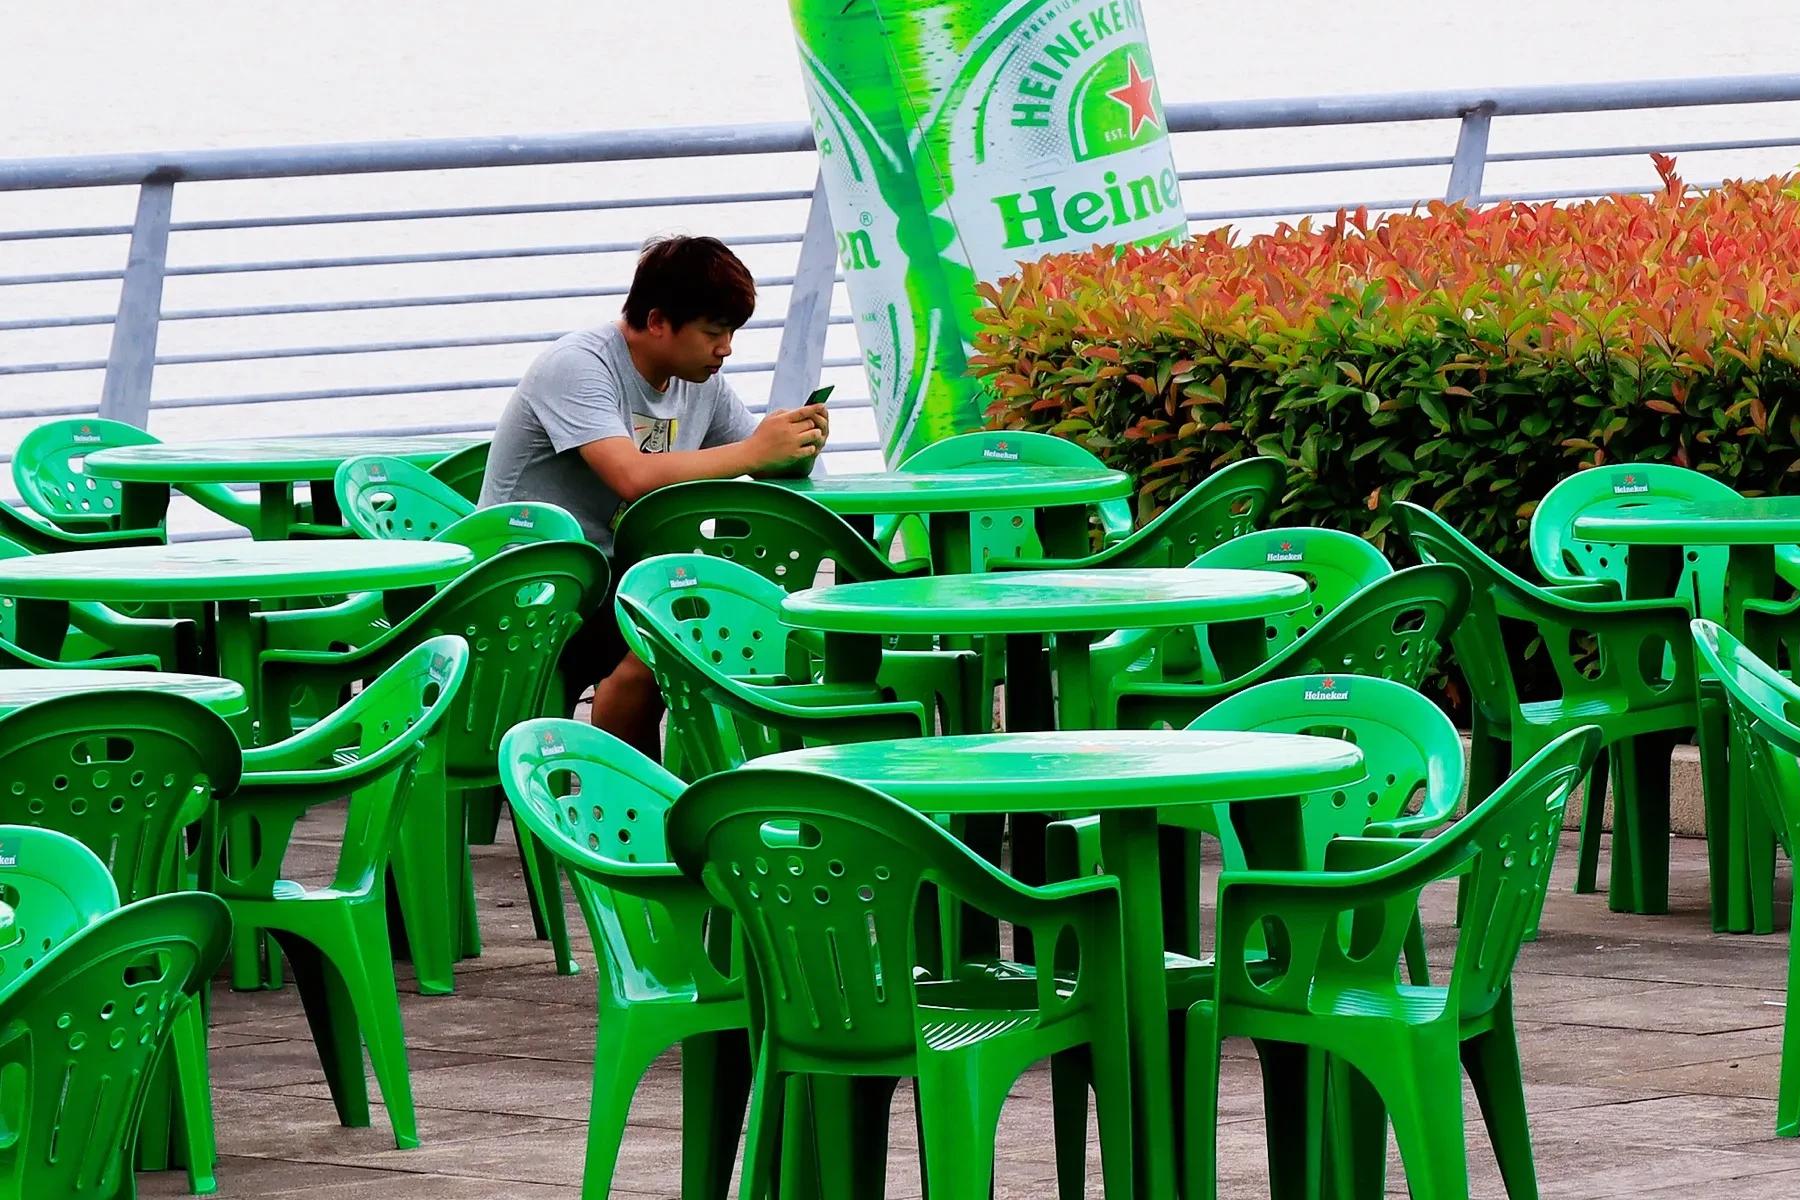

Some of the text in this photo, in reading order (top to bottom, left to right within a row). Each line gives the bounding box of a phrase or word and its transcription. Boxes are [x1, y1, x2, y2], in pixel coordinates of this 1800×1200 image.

[984, 449, 1018, 460] Heineken
[1614, 486, 1649, 495] Heineken
[1267, 552, 1303, 562] Heineken
[669, 577, 698, 589] Heineken
[1304, 690, 1349, 701] Heineken
